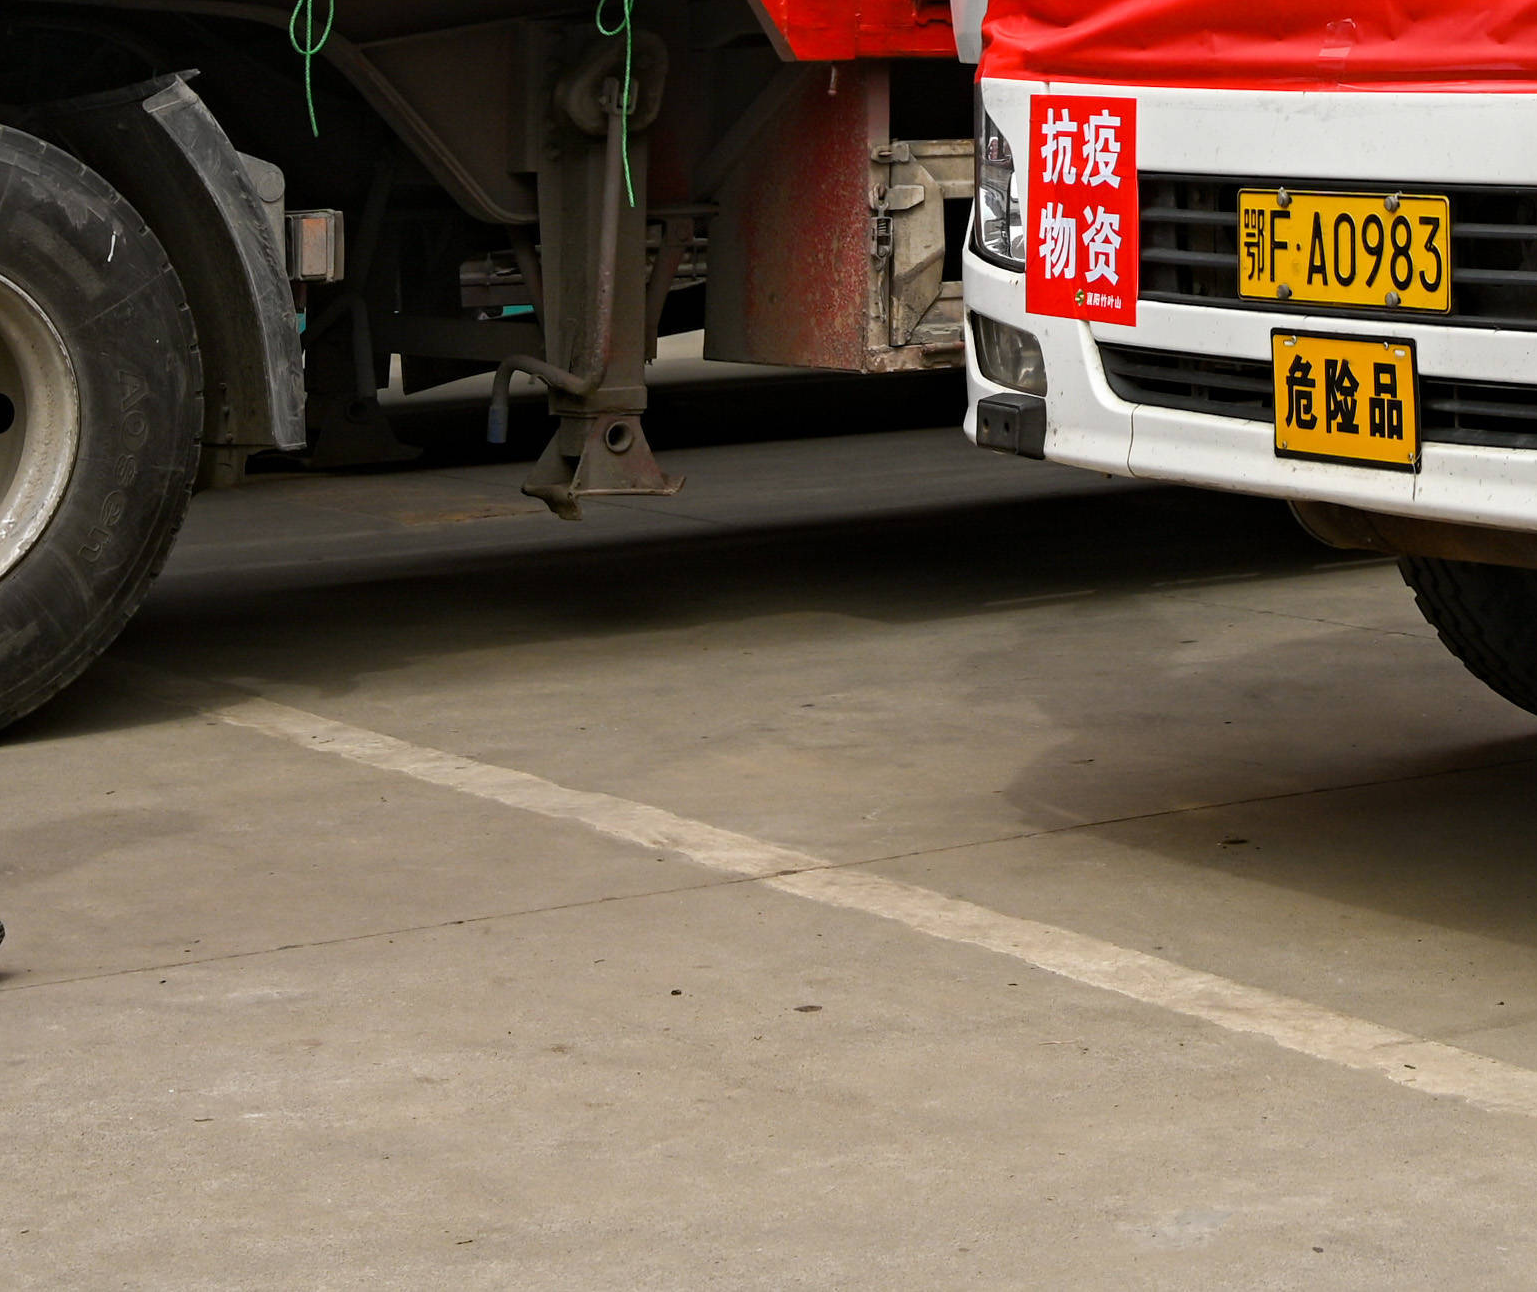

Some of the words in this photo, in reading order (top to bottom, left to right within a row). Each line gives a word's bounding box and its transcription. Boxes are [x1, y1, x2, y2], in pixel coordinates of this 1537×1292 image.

[1041, 107, 1121, 189] 抗疫
[1039, 201, 1122, 286] 物资
[1285, 354, 1404, 440] 危险品
